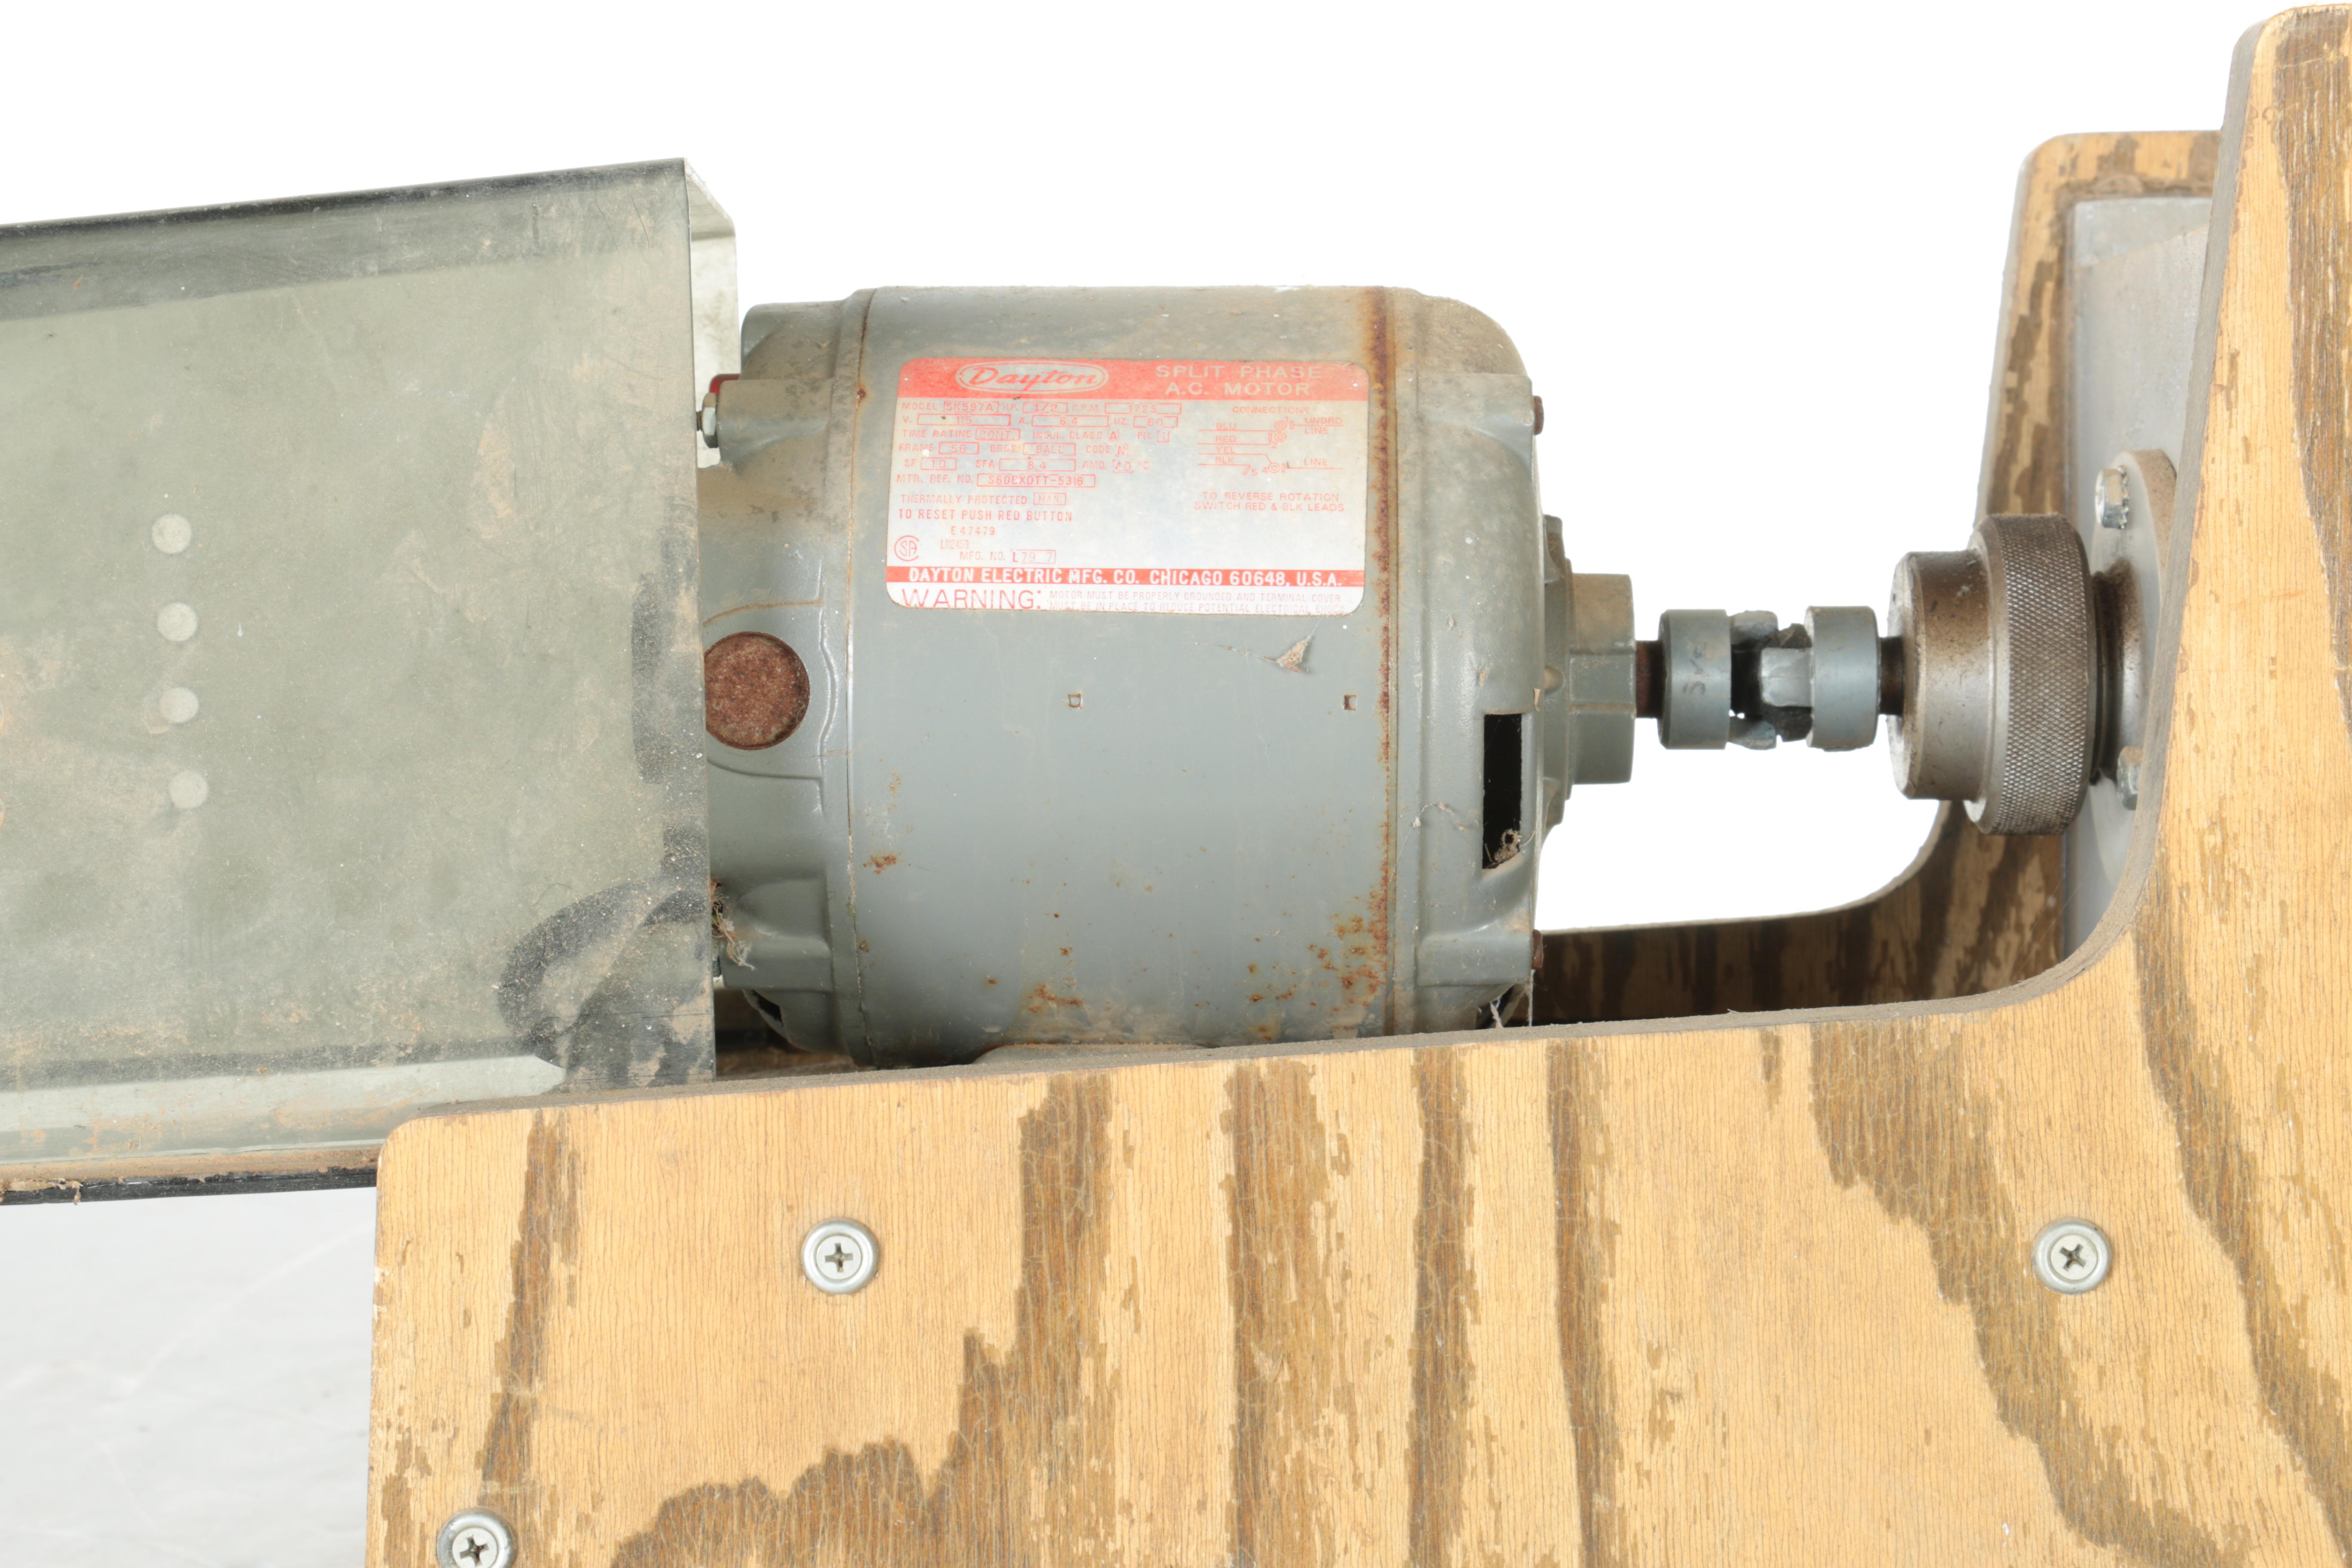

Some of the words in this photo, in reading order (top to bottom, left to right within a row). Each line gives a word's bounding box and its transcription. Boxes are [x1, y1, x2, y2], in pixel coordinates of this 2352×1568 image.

[1155, 366, 1225, 378] SPLIT
[1239, 366, 1323, 379] PHASE
[971, 365, 1096, 392] Dayton
[1165, 382, 1208, 395] A.C.
[1224, 383, 1310, 396] MOTOR
[1034, 404, 1058, 412] 1/2
[1129, 405, 1157, 413] 1725
[957, 416, 971, 424] 115
[1060, 417, 1078, 425] 8.4
[1148, 418, 1163, 426] 60
[979, 431, 1016, 439] CONT.
[1109, 432, 1118, 441] A
[1138, 432, 1152, 440] PH.
[951, 444, 966, 453] 56
[990, 444, 1019, 453] BRGS.
[1036, 445, 1064, 454] BALL
[1087, 445, 1110, 453] CODE
[1118, 446, 1125, 455] N
[976, 460, 995, 468] SFA
[1028, 460, 1046, 470] 8.4
[1115, 462, 1131, 472] 40
[897, 475, 923, 483] MTR.
[930, 475, 951, 483] REF.
[958, 475, 973, 483] NO.
[901, 495, 962, 504] THERMALLY
[968, 495, 1027, 505] PROTECTED
[1038, 495, 1063, 503] MAN.
[1225, 492, 1272, 500] REVERSE
[1280, 493, 1339, 501] ROTATION
[1194, 502, 1240, 510] SWITCH
[1308, 503, 1344, 511] LEADS
[899, 509, 912, 519] TO
[919, 509, 955, 519] RESET
[962, 510, 992, 520] PUSH
[998, 510, 1020, 520] RED
[1026, 511, 1072, 521] BUTTON
[960, 551, 984, 560] MFG.
[990, 551, 1006, 560] NO.
[909, 568, 974, 582] DAYTON
[981, 568, 1062, 583] ELECTRIC
[1069, 569, 1107, 583] MFG.
[1114, 570, 1139, 584] CO.
[1150, 570, 1222, 585] CHICAGO
[1297, 571, 1341, 586] U.S.A.
[902, 589, 1041, 609] WARNING:
[1050, 591, 1082, 599] MOTOR
[1087, 591, 1113, 599] MUST
[1133, 591, 1179, 600] PROPERLY
[1185, 592, 1231, 601] GROUNDED
[1237, 593, 1255, 601] AND
[1260, 593, 1306, 602] TERMINAL
[1312, 594, 1341, 602] COVER
[1050, 602, 1076, 610] MUST
[1096, 602, 1105, 611] IN
[1109, 603, 1138, 611] PLACE
[1143, 603, 1155, 611] TO
[1160, 603, 1193, 612] REDUCE
[1199, 603, 1250, 612] POTENTIAL
[1256, 604, 1310, 613] ELECTRICAL
[1316, 604, 1347, 614] SHOCK.
